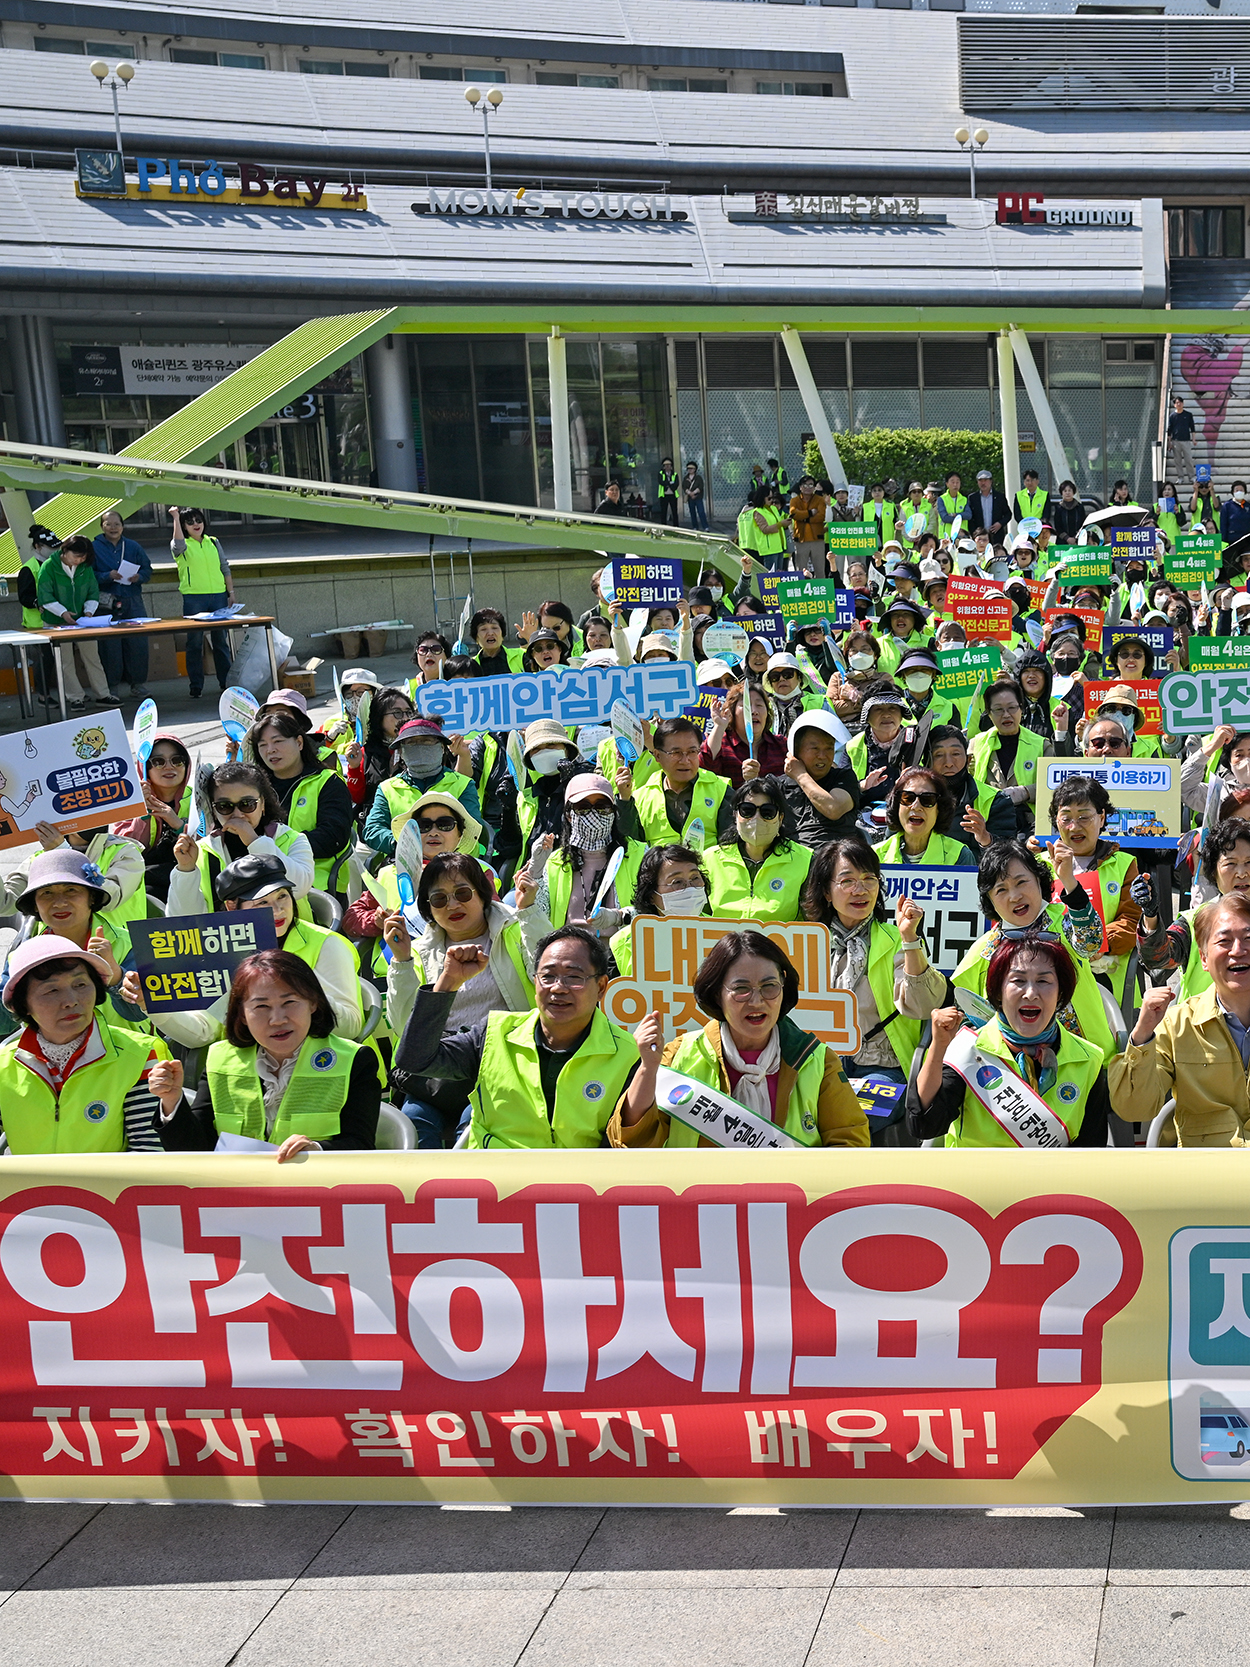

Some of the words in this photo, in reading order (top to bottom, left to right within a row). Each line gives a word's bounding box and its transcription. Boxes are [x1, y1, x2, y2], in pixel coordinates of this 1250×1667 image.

[238, 162, 326, 206] Bay
[341, 184, 364, 202] 2F
[428, 187, 545, 215] MOM'S
[553, 192, 672, 220] TOUCH
[997, 192, 1044, 223] PC
[1046, 209, 1131, 225] GROUND
[132, 358, 188, 371] 애슐리퀸즈
[831, 538, 876, 548] 안전한바퀴
[1116, 531, 1149, 542] 함께하면
[1112, 547, 1154, 557] 안전합니다
[620, 565, 673, 579] 함께하면
[616, 587, 681, 602] 안전합니다
[781, 600, 826, 617] 안전점검의
[942, 657, 959, 668] 매월
[962, 651, 989, 666] 4일은
[1201, 645, 1219, 656] 매월
[1222, 640, 1250, 656] 4일은
[423, 669, 690, 731] 함께안심서구
[56, 760, 120, 790] 불필요한
[1112, 770, 1166, 785] 이용하기
[60, 789, 92, 811] 조명
[93, 780, 128, 803] 끄기
[885, 877, 959, 901] 께안심
[148, 922, 257, 958] 함께하면
[689, 1095, 724, 1123] 매월
[0, 1198, 1123, 1394] 안전하세요?
[33, 1406, 287, 1466] 지키자!
[345, 1408, 680, 1468] 확인하자!
[744, 1408, 998, 1469] 배우자!
